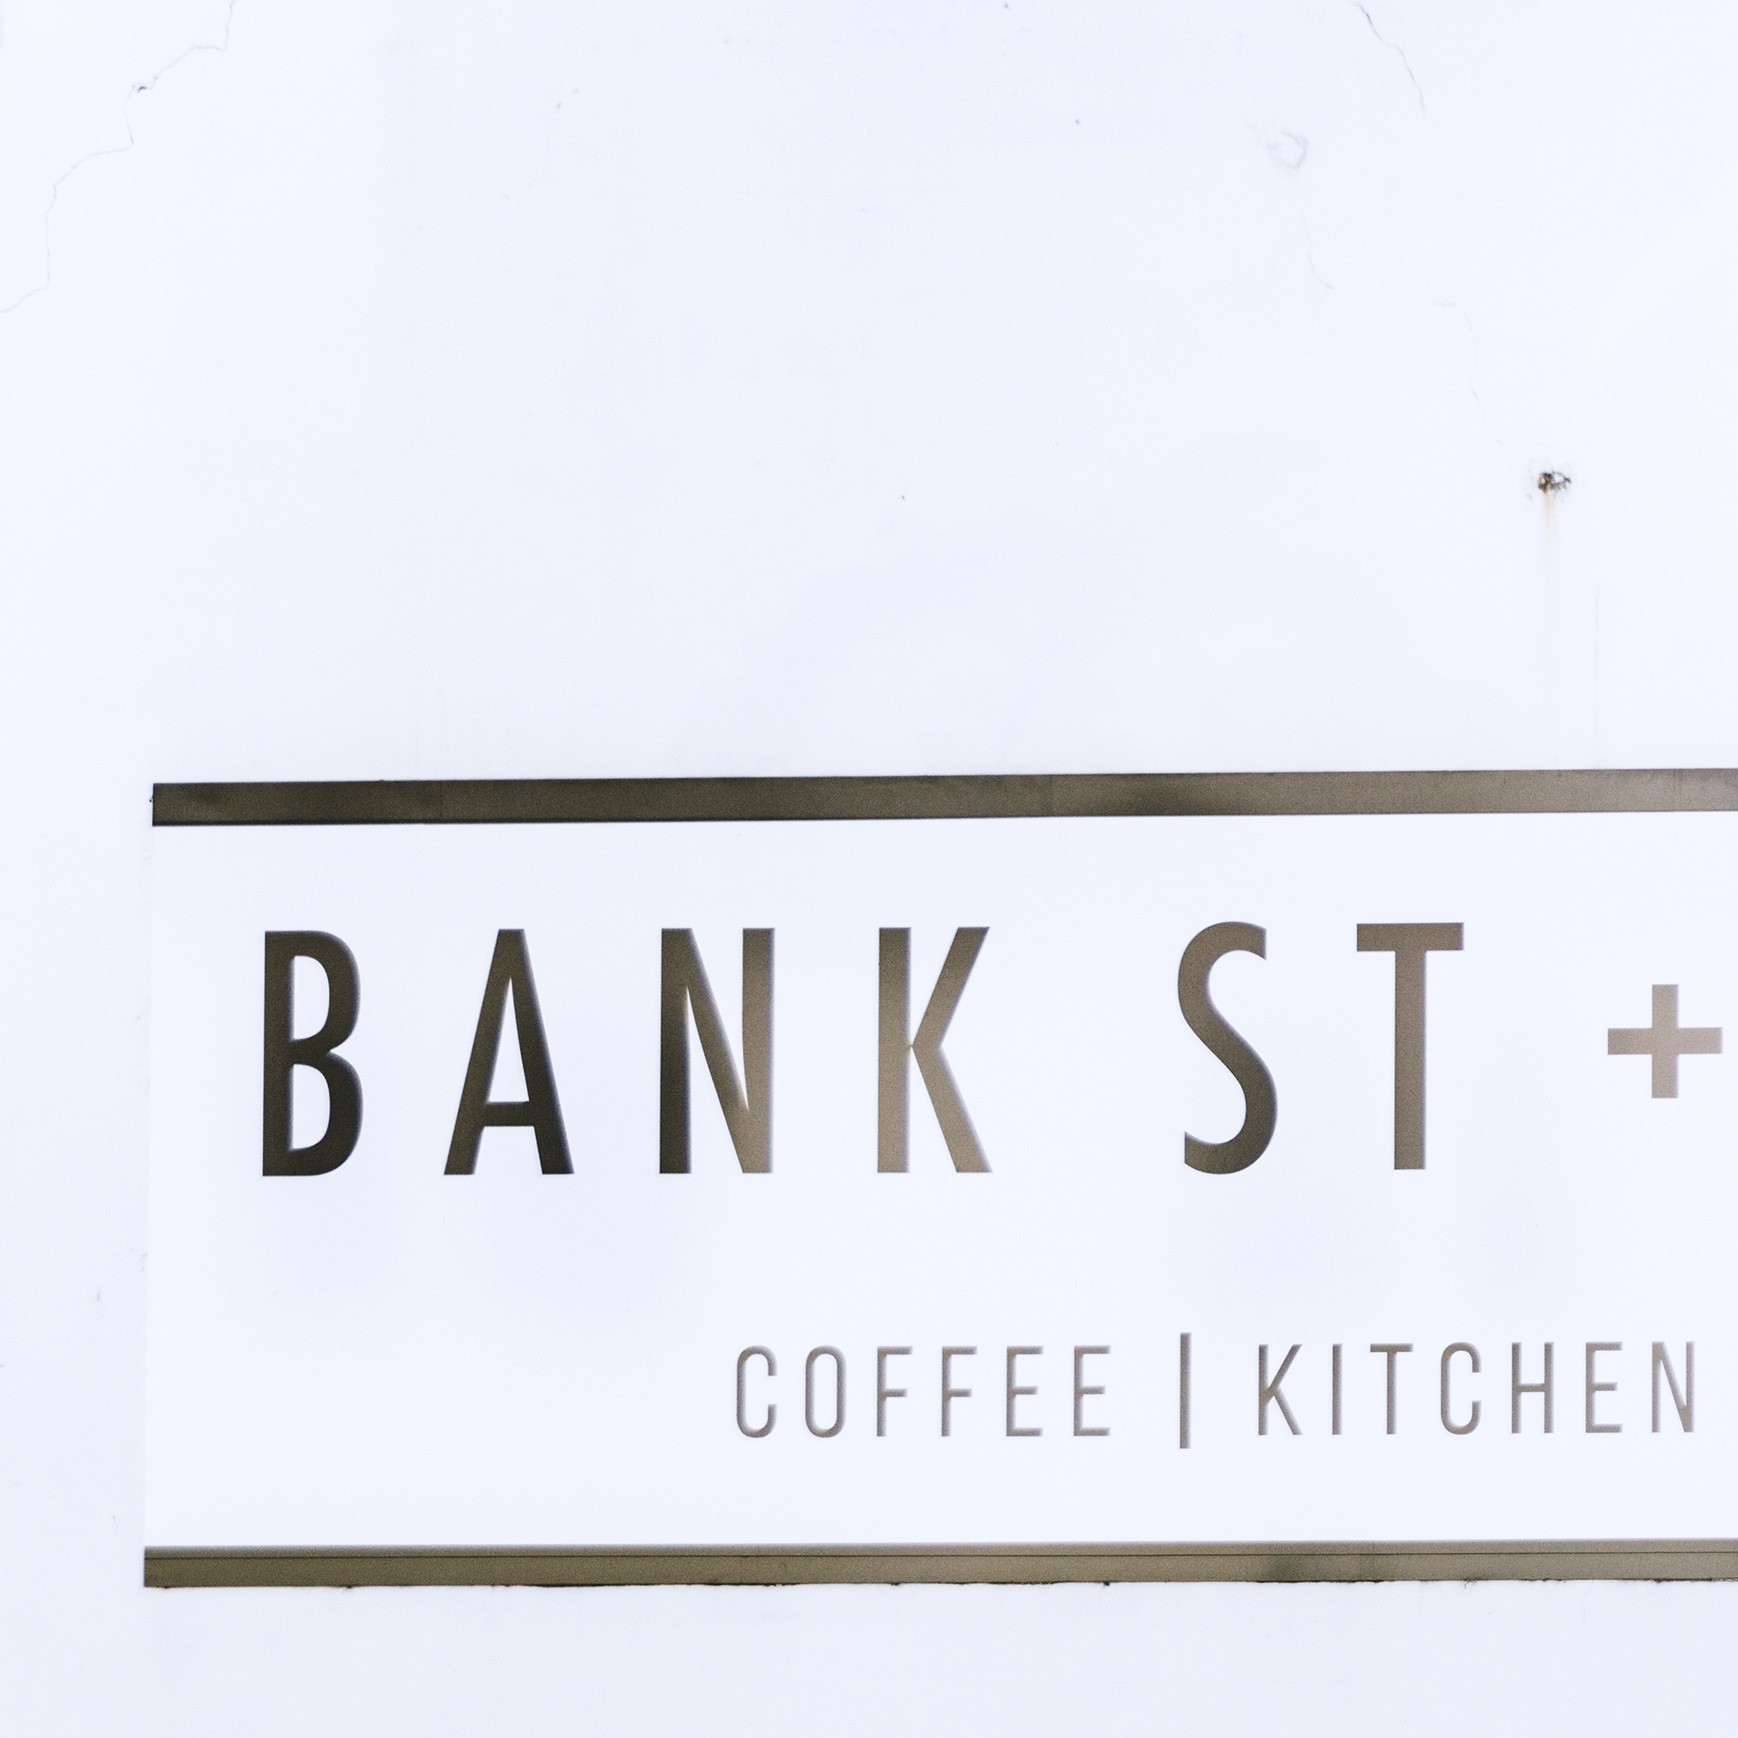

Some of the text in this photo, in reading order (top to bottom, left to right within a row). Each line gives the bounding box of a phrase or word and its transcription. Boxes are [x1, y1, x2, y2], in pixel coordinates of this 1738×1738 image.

[262, 927, 991, 1177] BANK
[1177, 921, 1464, 1175] ST
[1608, 985, 1721, 1098] +
[736, 1346, 1110, 1438] COFFEE
[1258, 1342, 1693, 1436] KITCHEN
